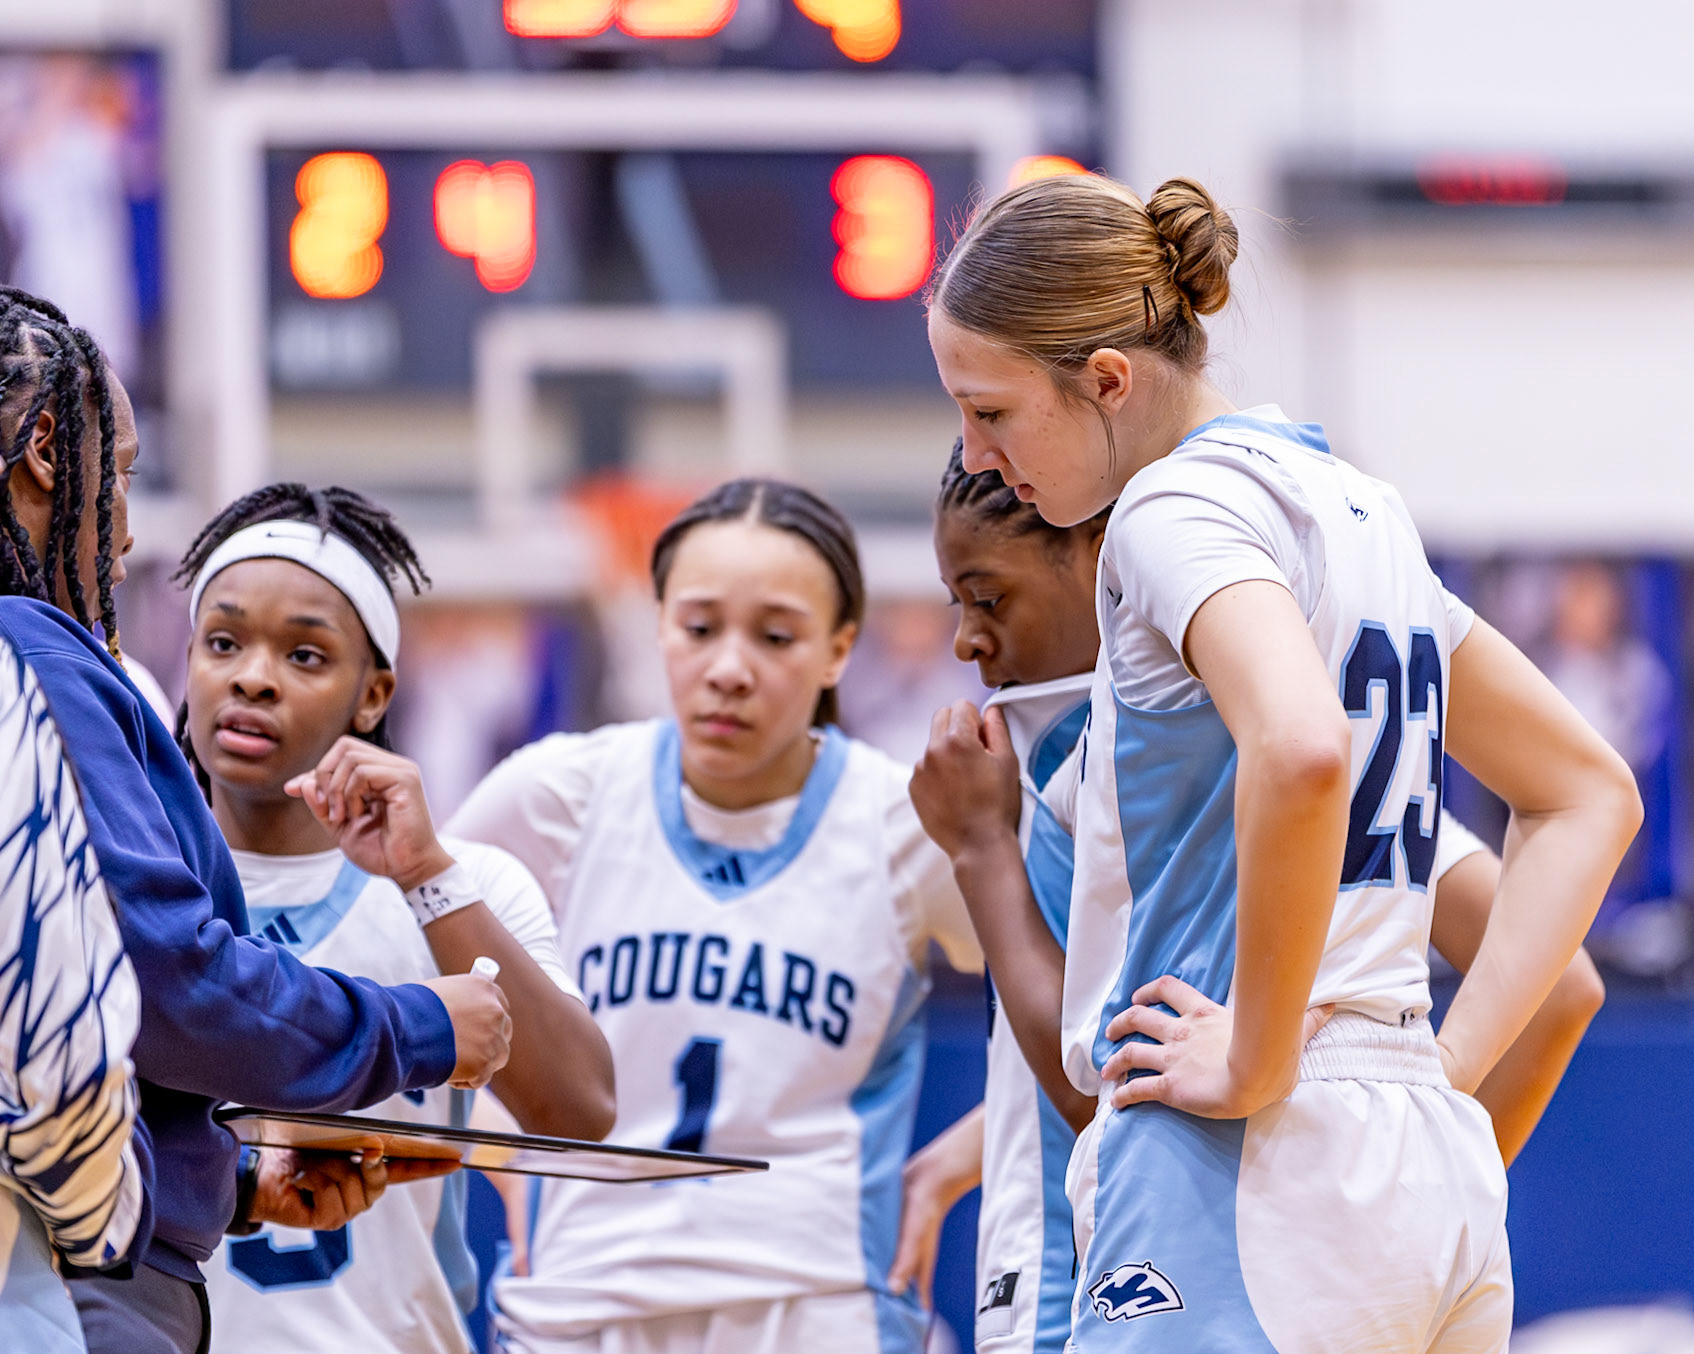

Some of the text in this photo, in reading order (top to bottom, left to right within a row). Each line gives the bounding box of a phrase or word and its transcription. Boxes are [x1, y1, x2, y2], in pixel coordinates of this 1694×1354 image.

[1338, 619, 1444, 895] 23
[577, 932, 857, 1050] COUGARS
[656, 1036, 724, 1162] 1
